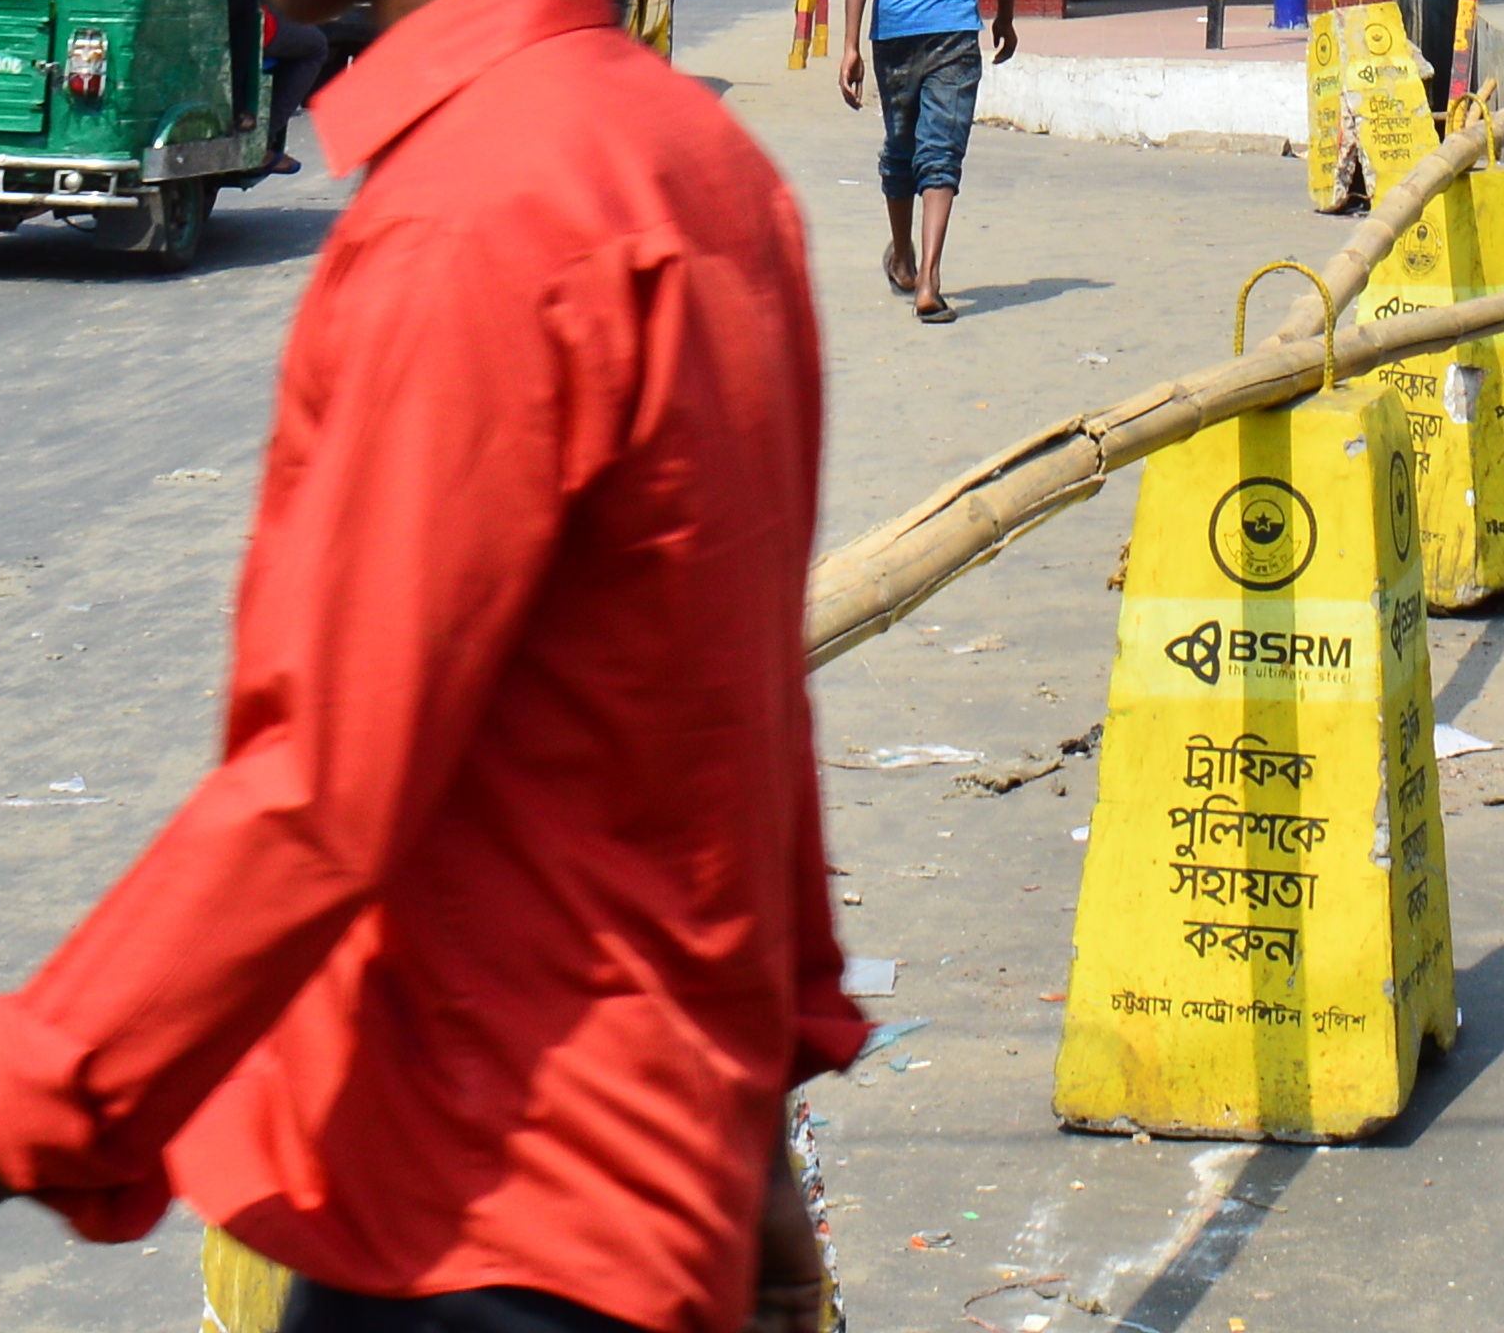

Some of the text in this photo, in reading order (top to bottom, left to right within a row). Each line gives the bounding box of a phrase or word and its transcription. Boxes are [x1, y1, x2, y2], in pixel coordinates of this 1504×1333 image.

[1229, 629, 1352, 669] BSRM
[1228, 664, 1352, 684] the ultimate steel
[1183, 733, 1316, 790] ট্রাফিক
[1168, 794, 1329, 859] পুলিশকে
[1169, 862, 1319, 910] সহায়তা
[1183, 920, 1299, 966] করুন
[1111, 989, 1366, 1034] চট্টগ্রাম মেট্রোপলিটন পুলিশ
